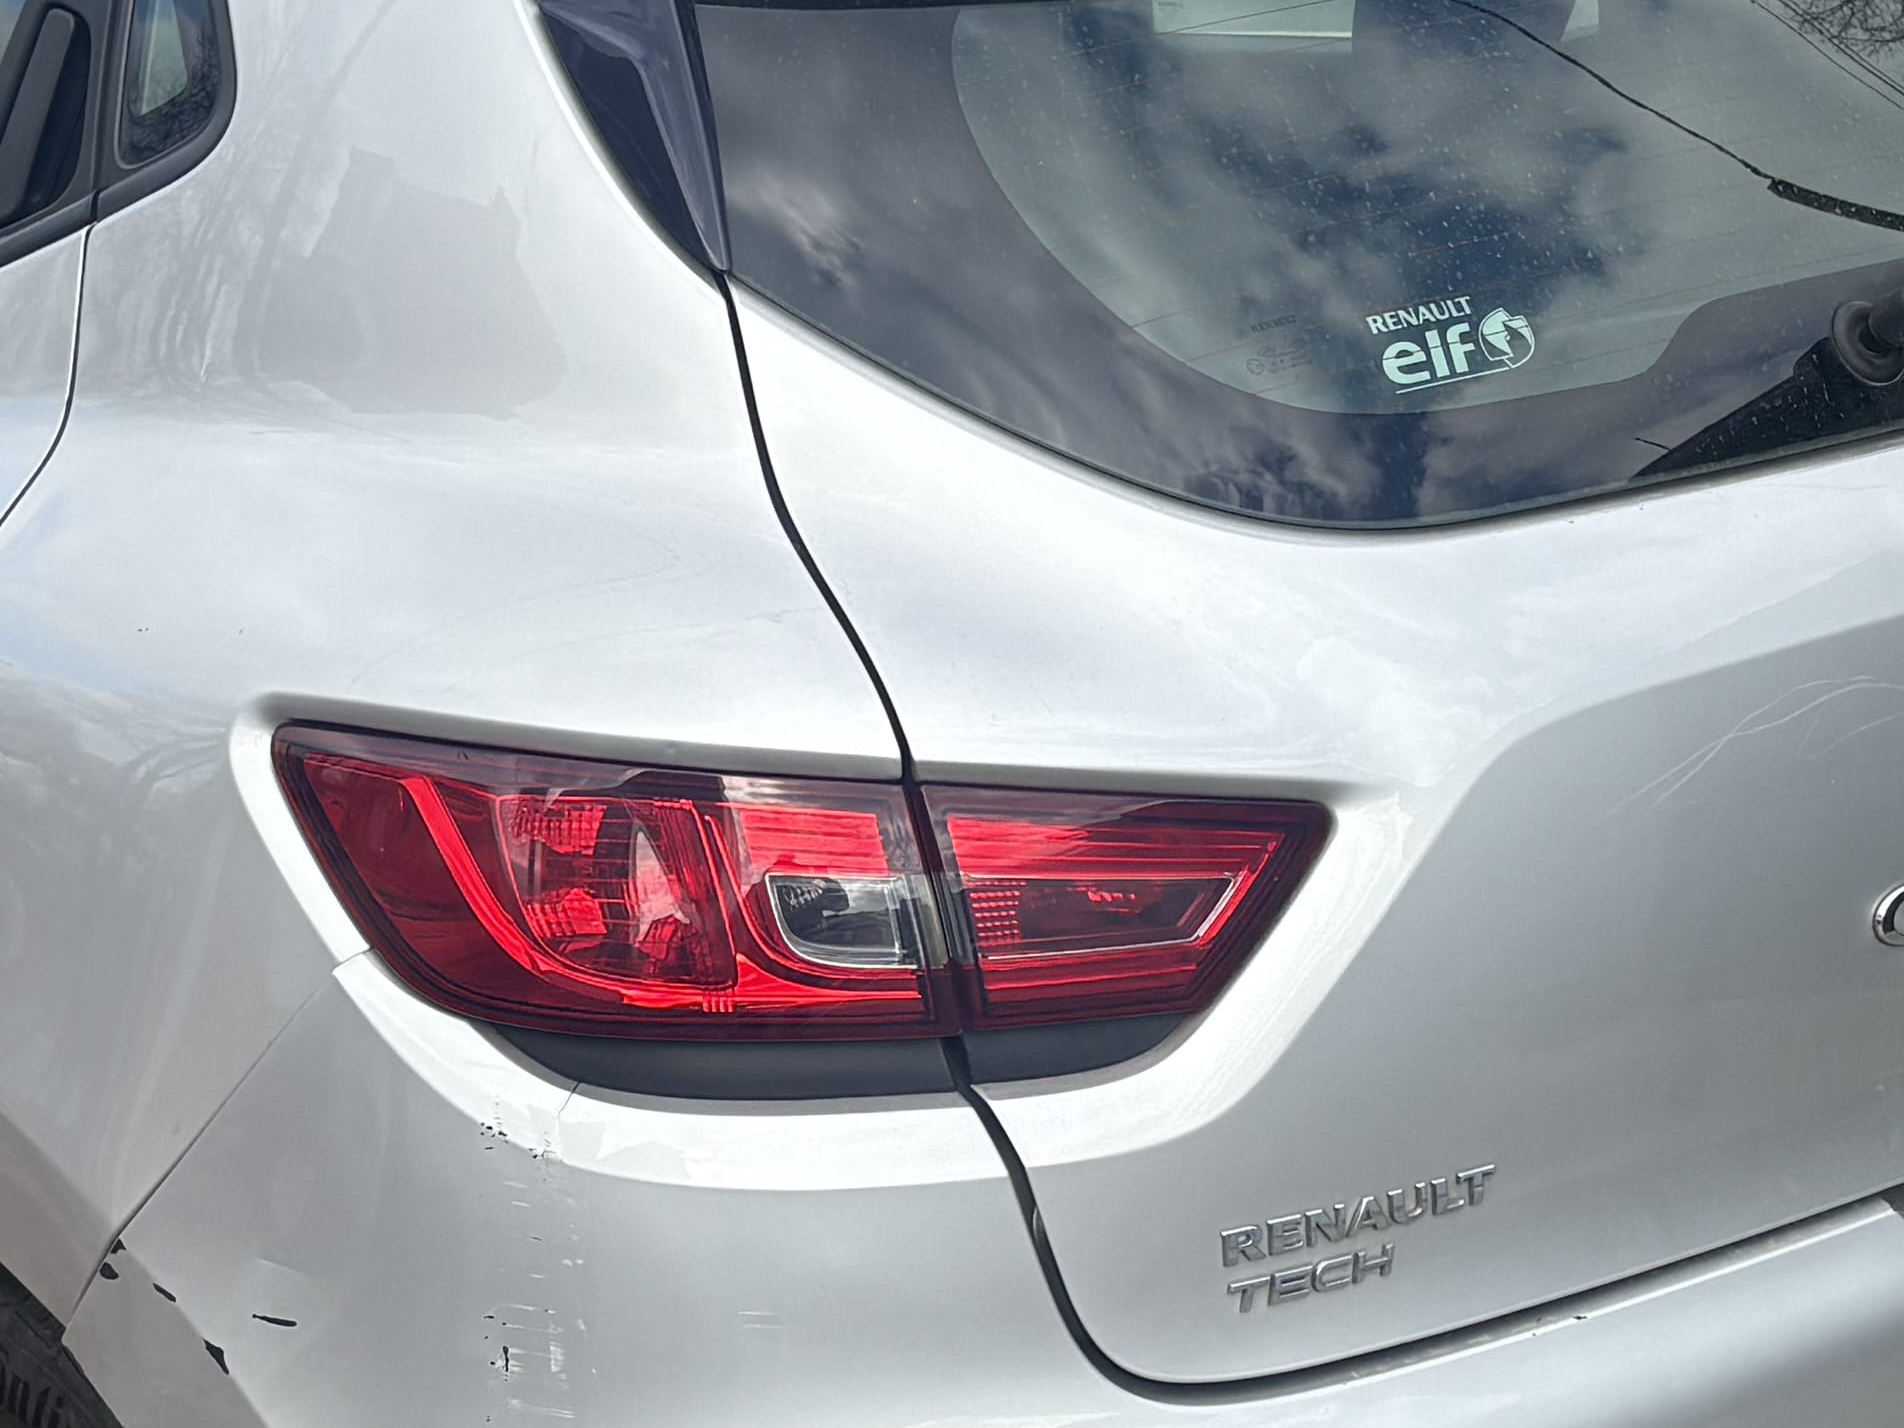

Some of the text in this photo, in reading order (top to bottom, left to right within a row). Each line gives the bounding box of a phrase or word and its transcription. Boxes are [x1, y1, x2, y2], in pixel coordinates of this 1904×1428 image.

[1366, 296, 1470, 334] RENAULT
[1382, 322, 1475, 384] elf
[1220, 1164, 1496, 1267] RENAULT
[1227, 1243, 1394, 1313] TECH
